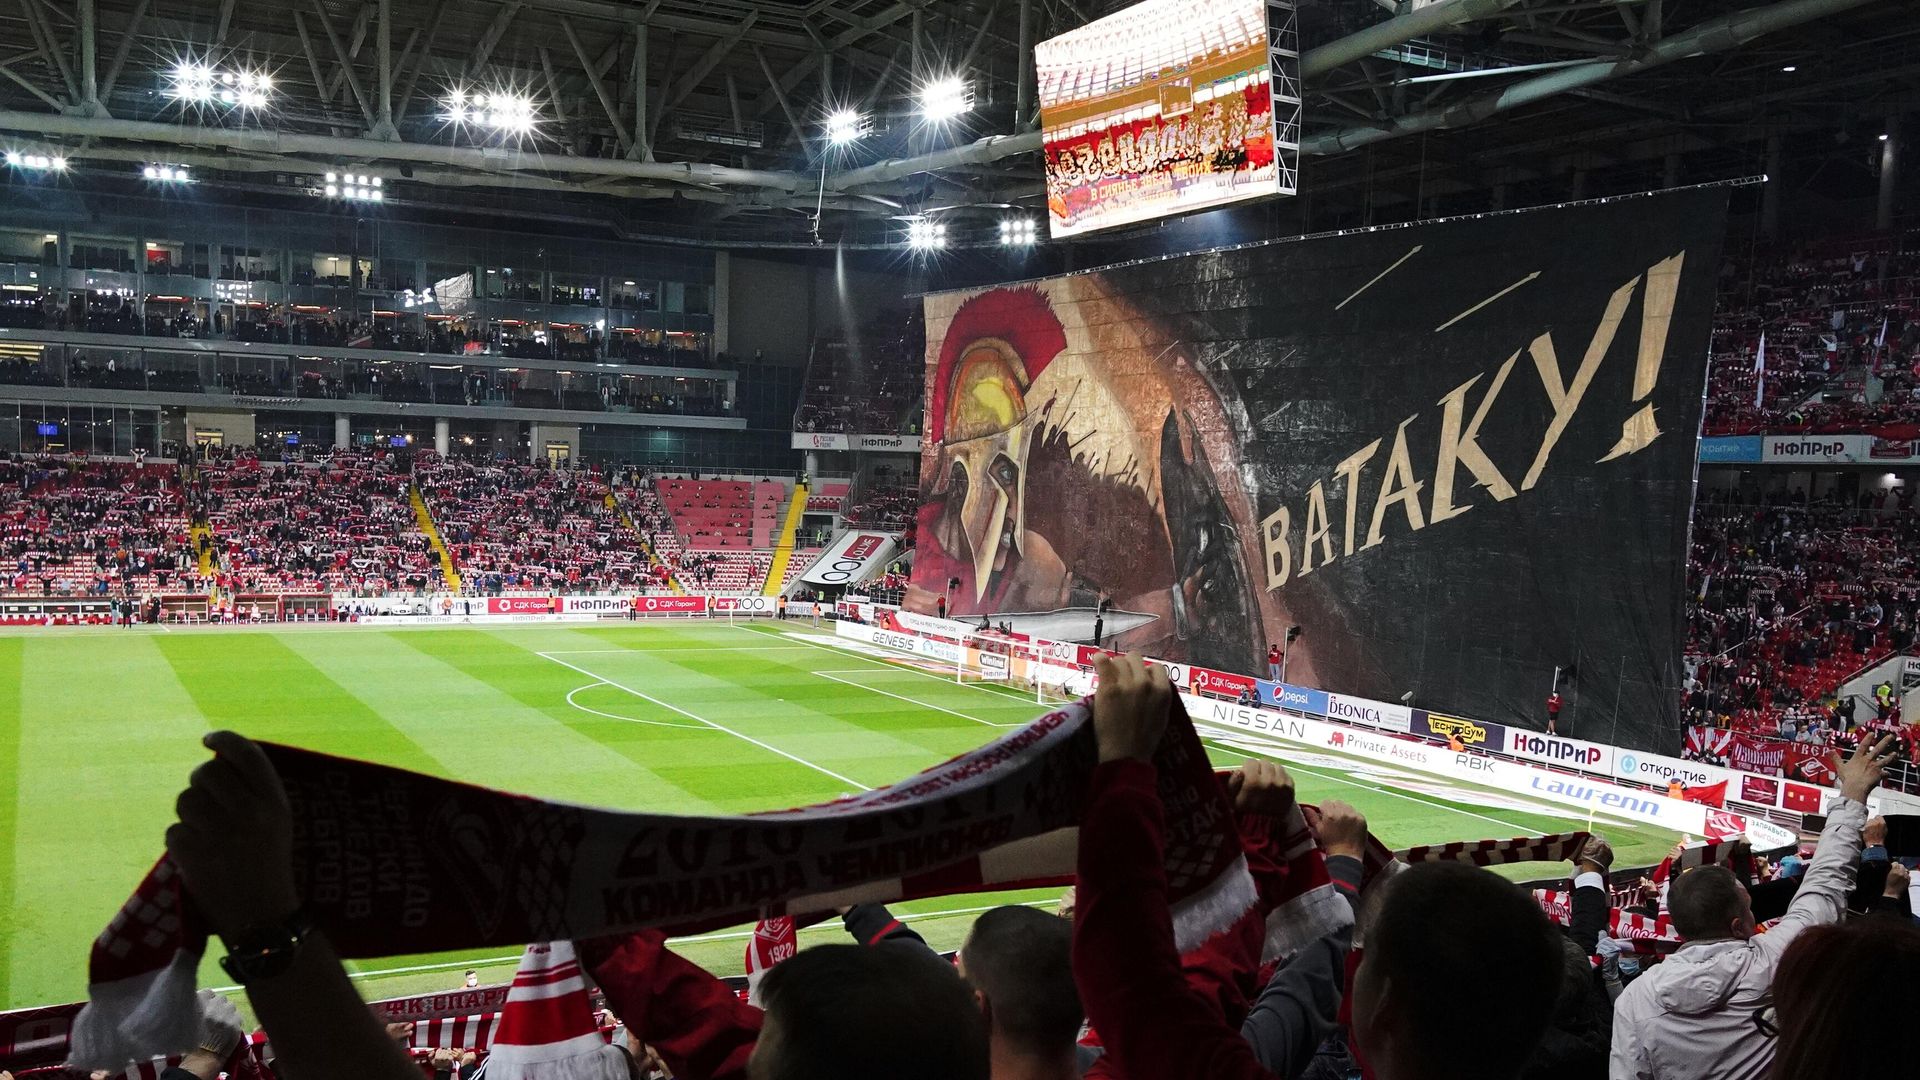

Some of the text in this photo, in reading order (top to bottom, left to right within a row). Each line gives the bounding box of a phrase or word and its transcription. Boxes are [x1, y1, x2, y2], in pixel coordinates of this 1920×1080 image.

[1773, 442, 1845, 456] НФПРиР
[570, 600, 629, 610] НФПРиР
[660, 601, 697, 610] СДК Гарант
[738, 598, 765, 609] 100
[872, 631, 915, 651] GENESIS
[1210, 676, 1226, 688] СДК
[1284, 691, 1309, 704] pepsi
[1213, 704, 1305, 738] NISSAN
[1329, 701, 1381, 723] DEONICA
[1347, 734, 1427, 764] Private Assets
[1514, 733, 1602, 765] НФПРиР
[1455, 754, 1496, 773] RBK
[602, 813, 1015, 927] КОМАНДА ЧЕМПИОНОВ
[385, 986, 511, 1016] ФК СПАРТ
